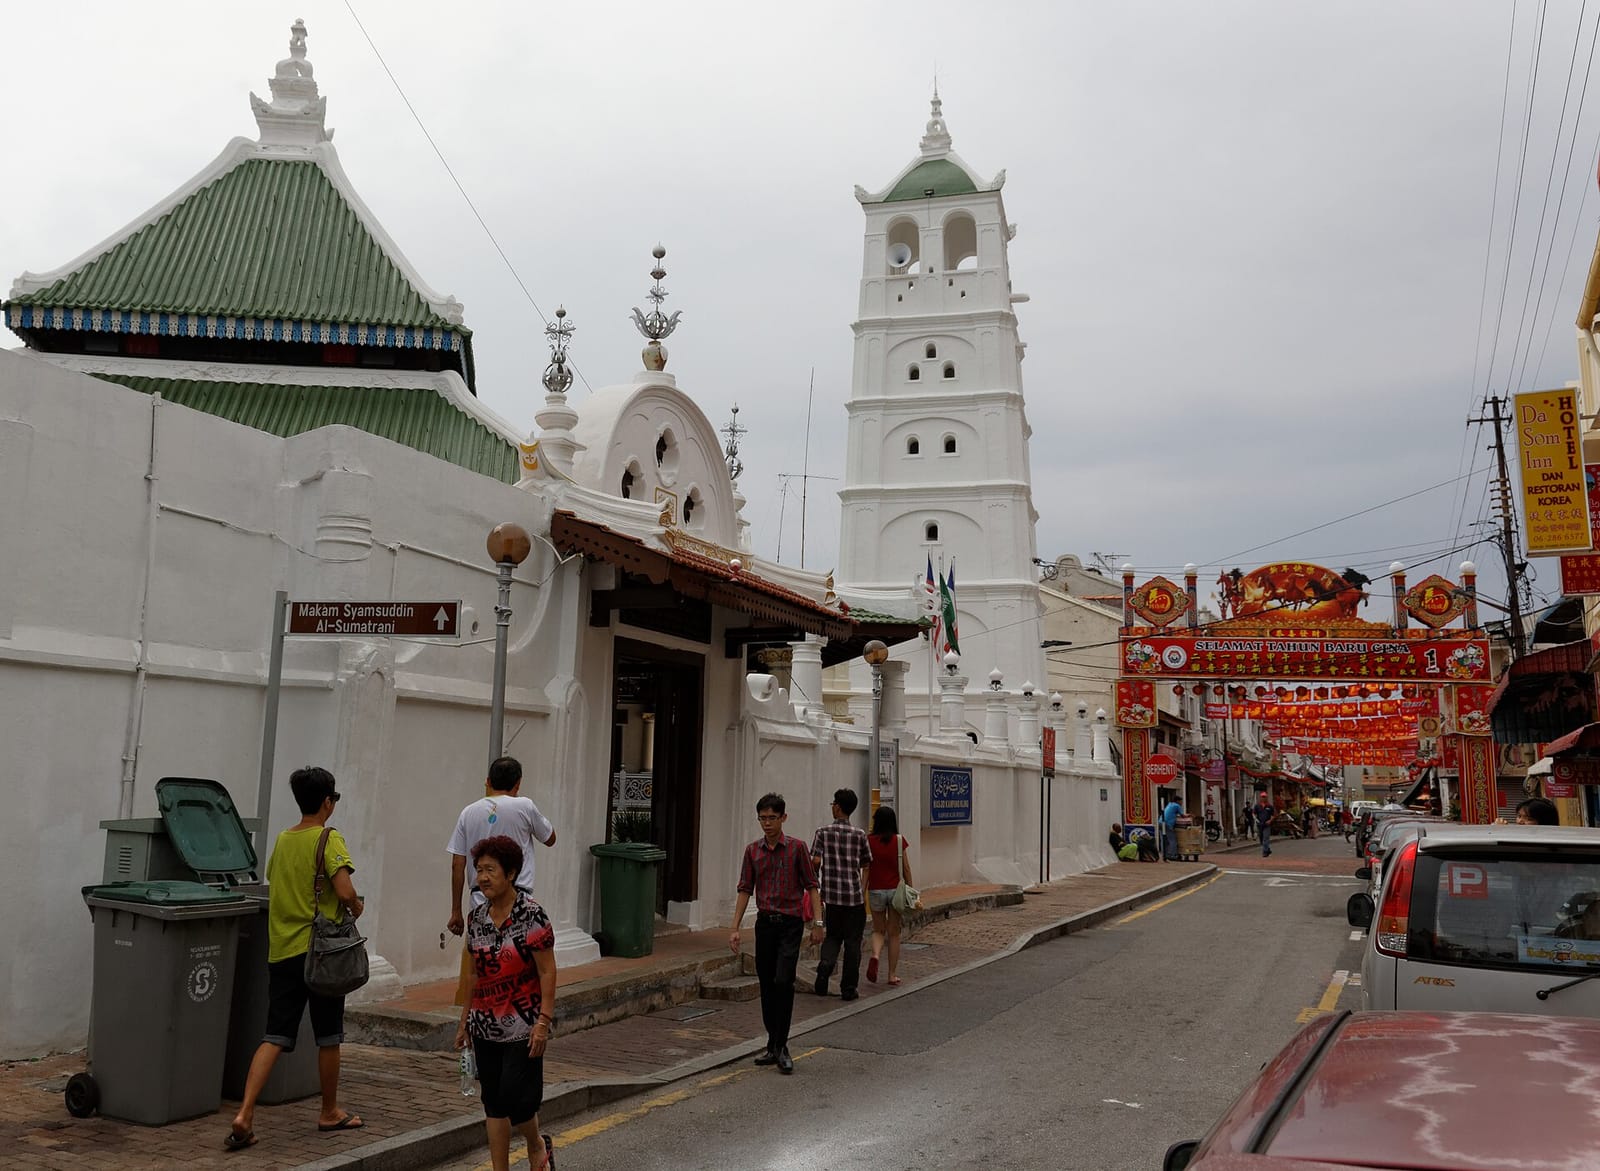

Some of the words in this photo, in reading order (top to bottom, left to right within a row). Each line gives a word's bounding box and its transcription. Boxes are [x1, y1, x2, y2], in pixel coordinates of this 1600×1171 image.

[1521, 405, 1547, 424] Da
[1523, 427, 1560, 446] Som
[1558, 396, 1578, 470] HOTEL
[1525, 451, 1553, 469] Inn
[1541, 471, 1563, 481] DAN
[1527, 483, 1580, 495] RESTORAN
[1538, 496, 1572, 506] KOREA
[299, 604, 339, 617] Makam
[343, 603, 414, 620] Syamsuddin
[316, 619, 395, 633] Al-Sumatrani
[1195, 640, 1264, 652] SELAMAT
[1266, 641, 1320, 652] TAHUN
[1325, 642, 1369, 653] BARU
[1371, 643, 1411, 654] CINA
[1424, 648, 1440, 673] 1
[1146, 763, 1176, 775] BERHENTI
[1452, 867, 1482, 894] P
